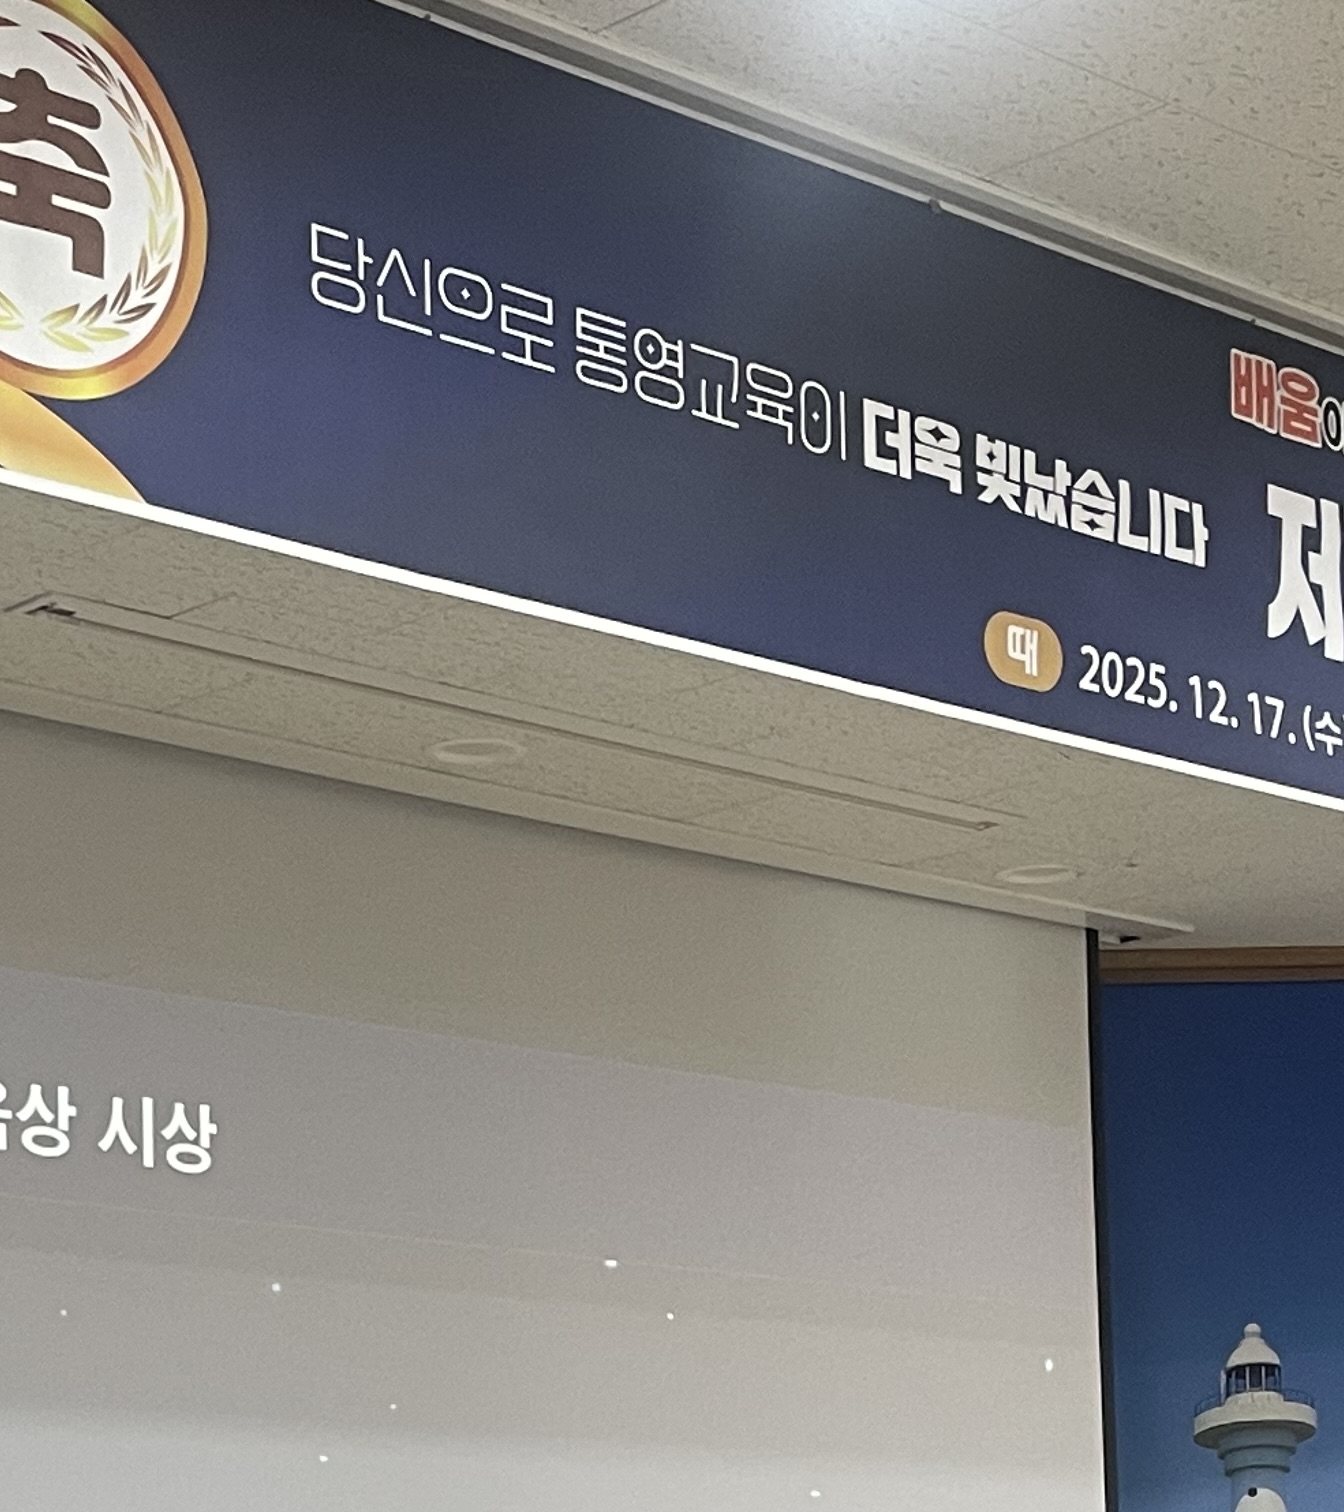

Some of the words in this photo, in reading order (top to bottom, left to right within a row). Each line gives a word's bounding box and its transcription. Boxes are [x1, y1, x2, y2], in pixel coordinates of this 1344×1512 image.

[309, 221, 555, 374] 당신으로
[575, 306, 848, 461] 통영교육이
[862, 397, 963, 496] 더욱
[975, 431, 1211, 569] 빛났습니다
[1006, 624, 1039, 678] 때
[1079, 645, 1179, 715] 2025.
[1188, 675, 1239, 728] 12.
[98, 1095, 218, 1175] 시상
